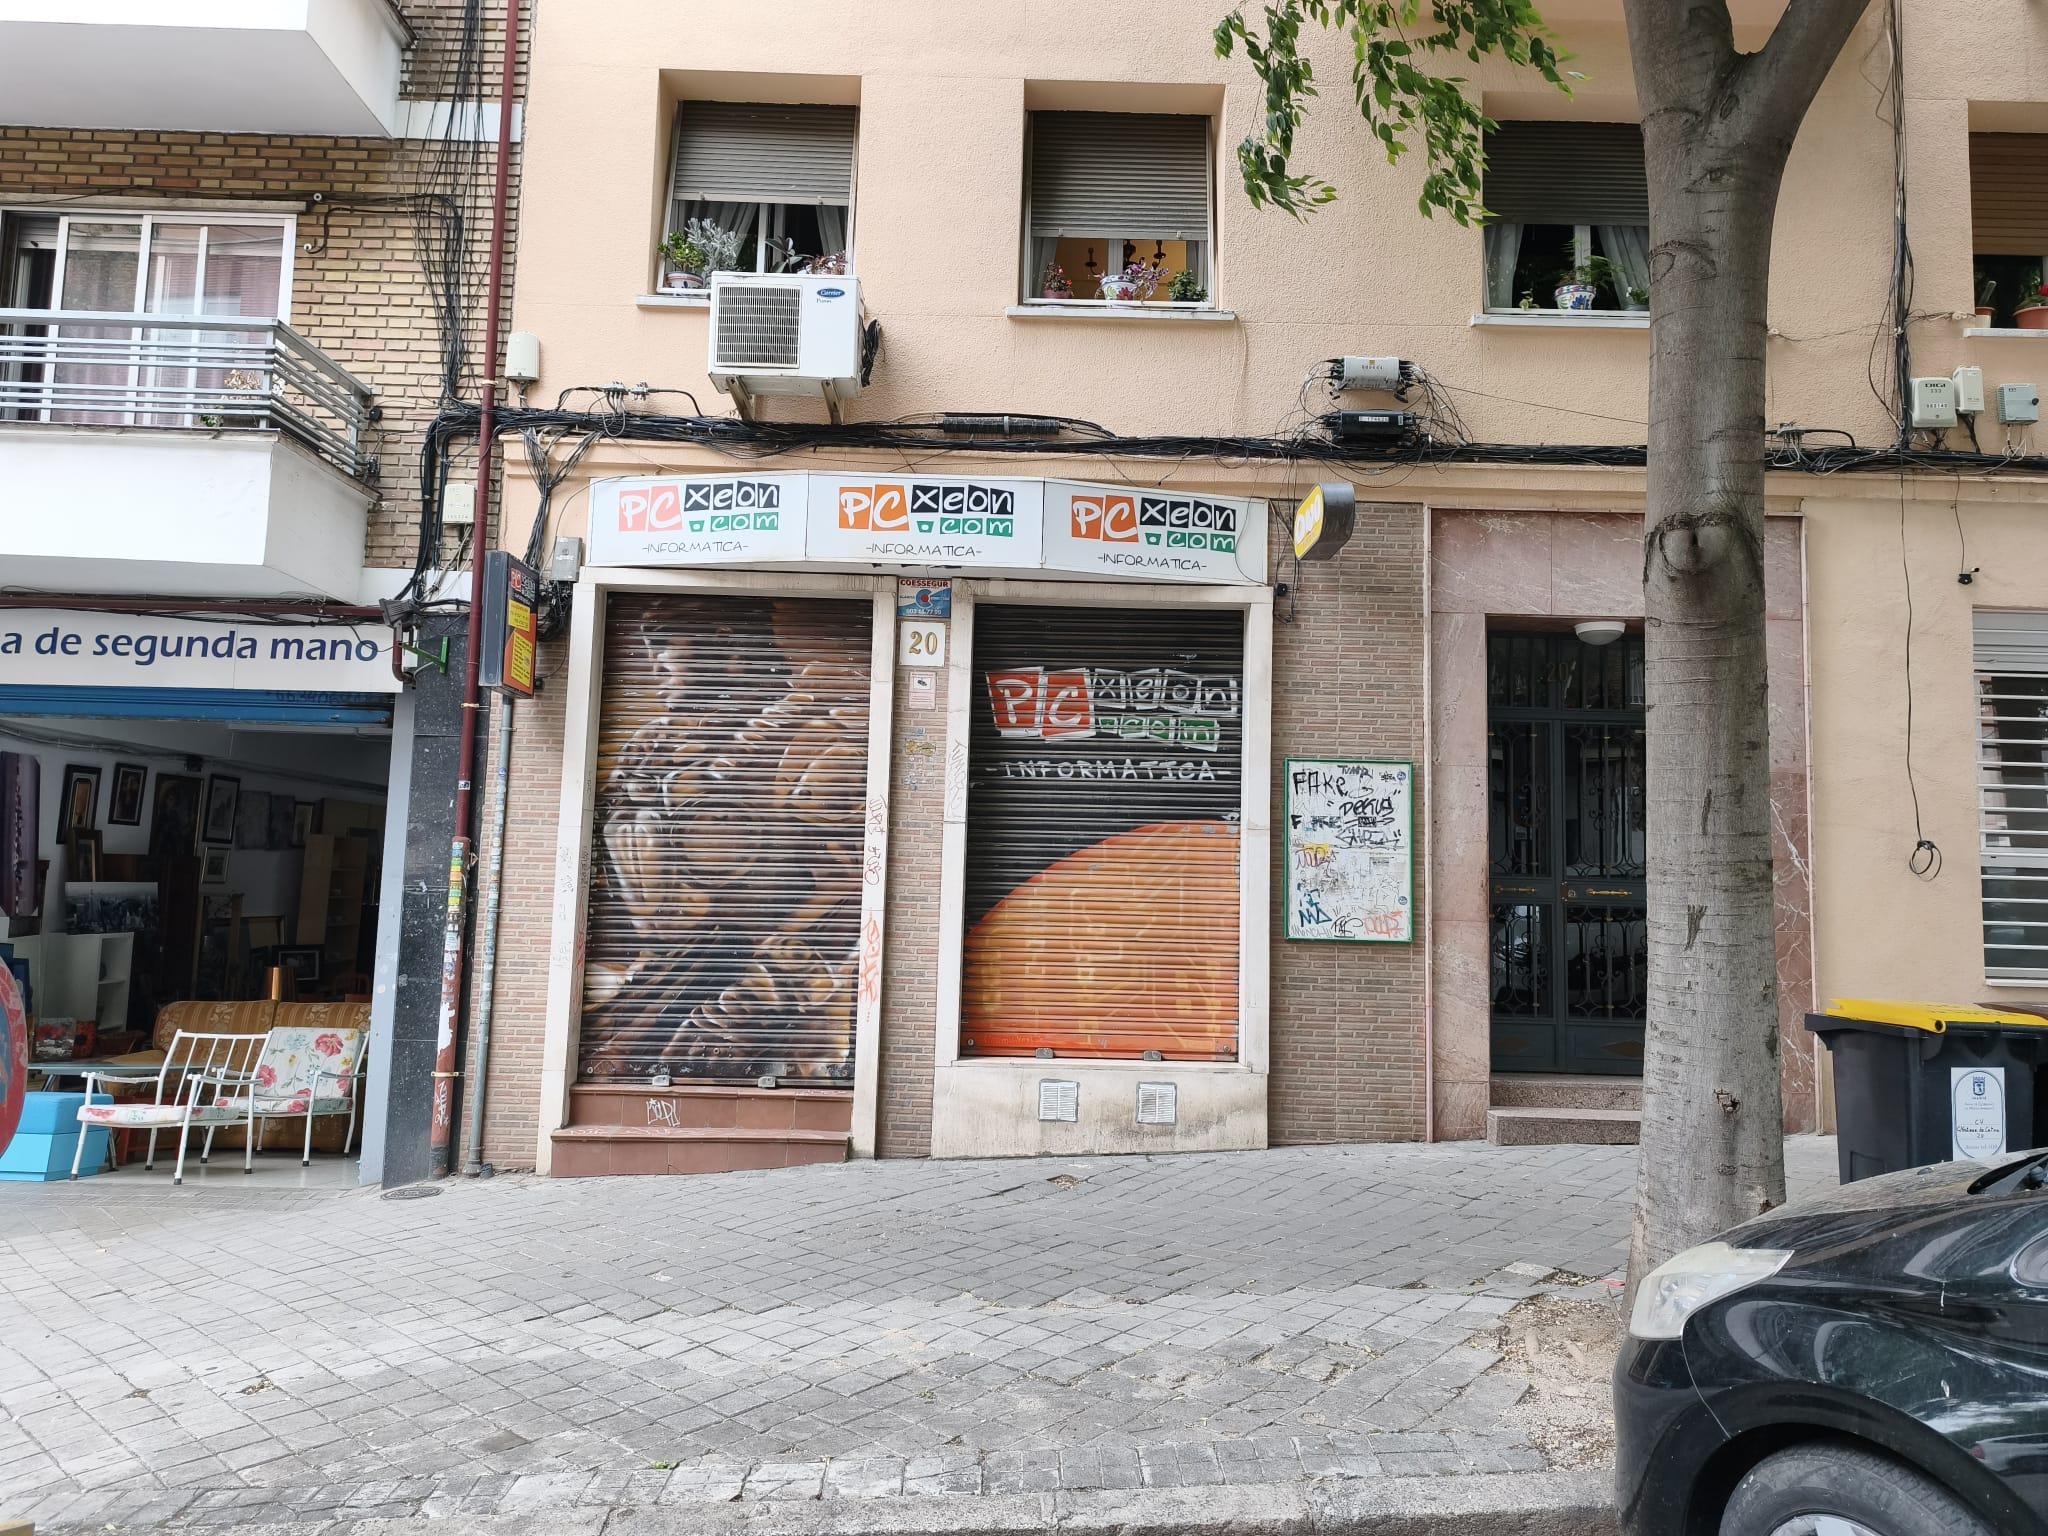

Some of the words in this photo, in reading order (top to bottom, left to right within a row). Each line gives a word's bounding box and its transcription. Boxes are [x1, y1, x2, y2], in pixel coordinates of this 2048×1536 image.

[621, 491, 682, 528] PC
[687, 484, 779, 510] xeon
[841, 490, 908, 528] PC
[914, 485, 1014, 513] xeon
[1073, 500, 1138, 540] PC
[1141, 498, 1236, 531] xeon
[900, 579, 949, 588] COESSEGUR
[35, 627, 82, 655] de
[92, 629, 257, 666] segunda
[270, 638, 378, 662] mano
[908, 630, 938, 655] 20
